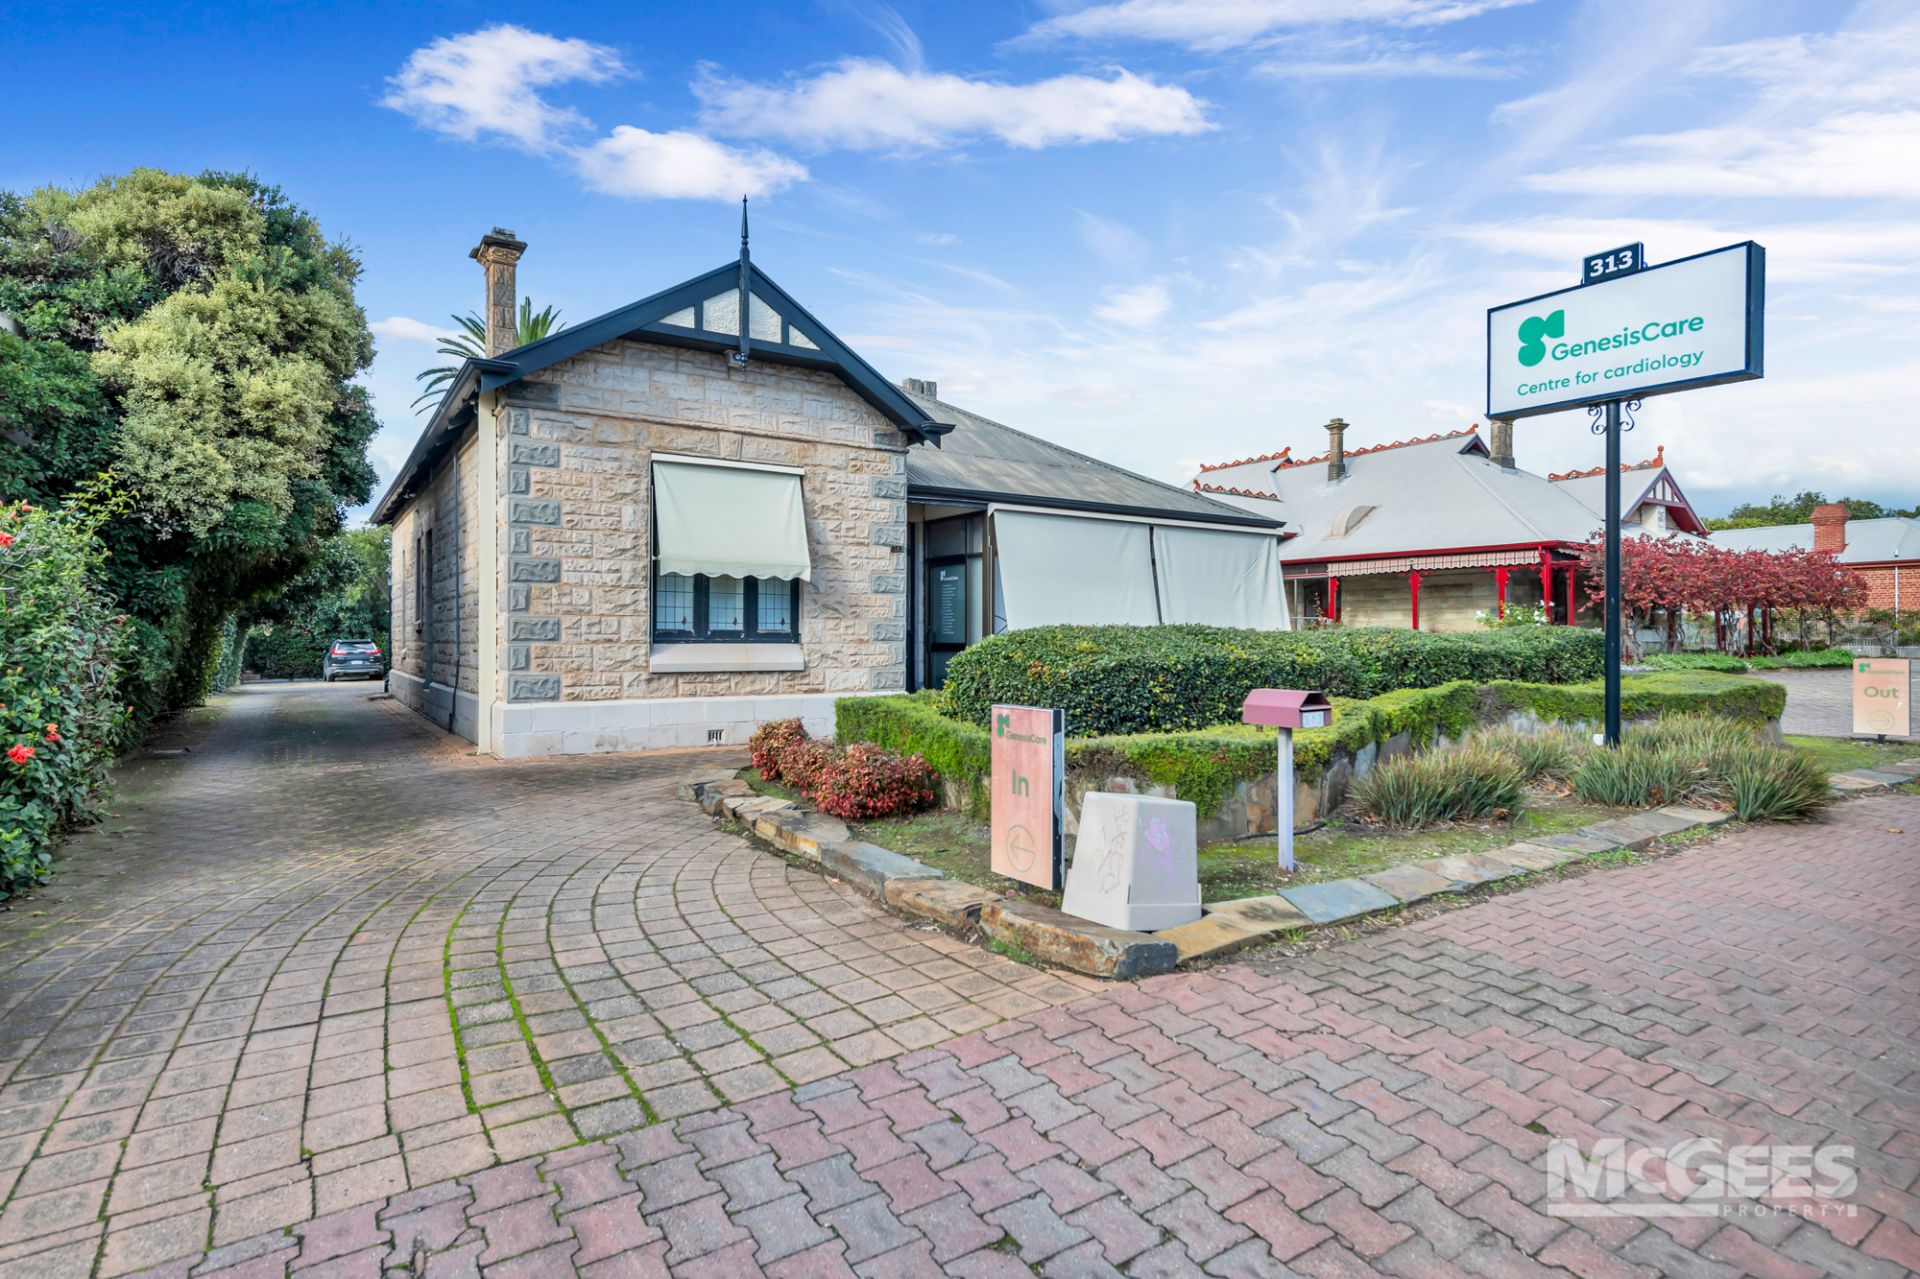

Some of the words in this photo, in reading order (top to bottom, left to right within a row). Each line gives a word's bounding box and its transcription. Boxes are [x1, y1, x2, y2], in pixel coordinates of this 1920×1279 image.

[1590, 250, 1633, 277] 313
[1551, 316, 1704, 361] GenesisCare
[1517, 374, 1571, 397] Centre
[1575, 369, 1599, 385] for
[1604, 350, 1704, 380] cardiology
[1864, 686, 1899, 699] Out
[1012, 769, 1029, 798] In
